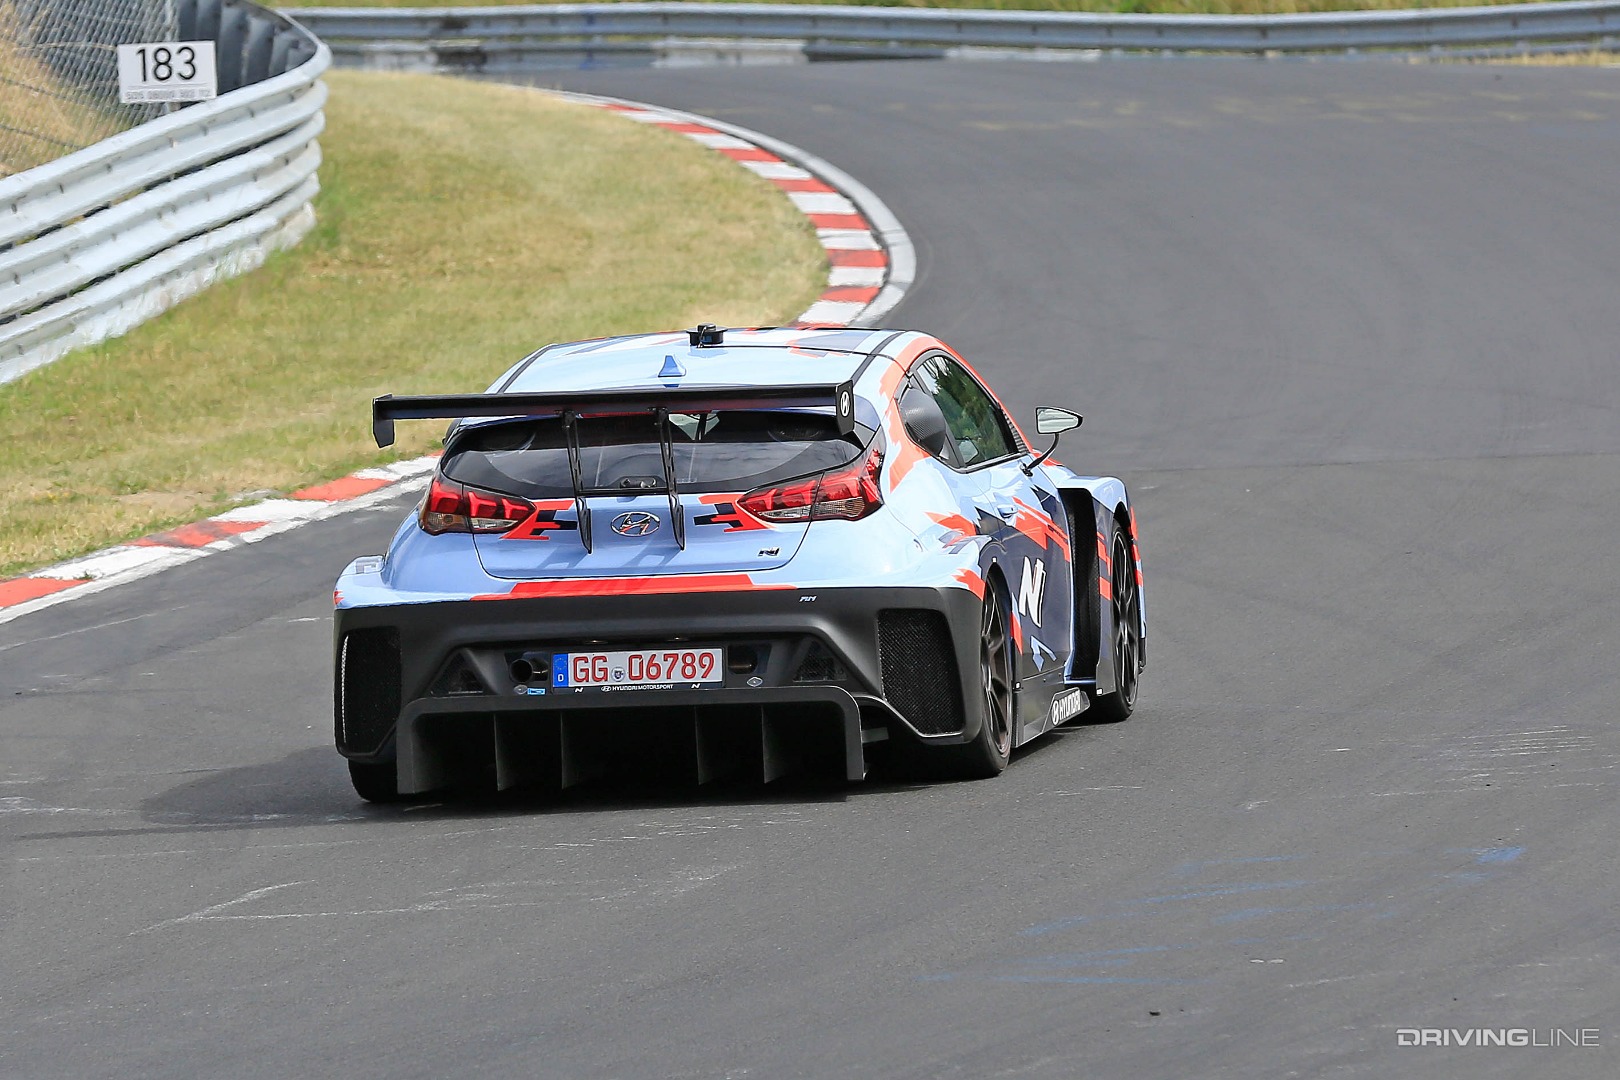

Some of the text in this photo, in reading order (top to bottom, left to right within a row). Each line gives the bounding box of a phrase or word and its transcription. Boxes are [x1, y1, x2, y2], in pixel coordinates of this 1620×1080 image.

[136, 47, 196, 82] 183
[573, 652, 715, 683] GG 06789
